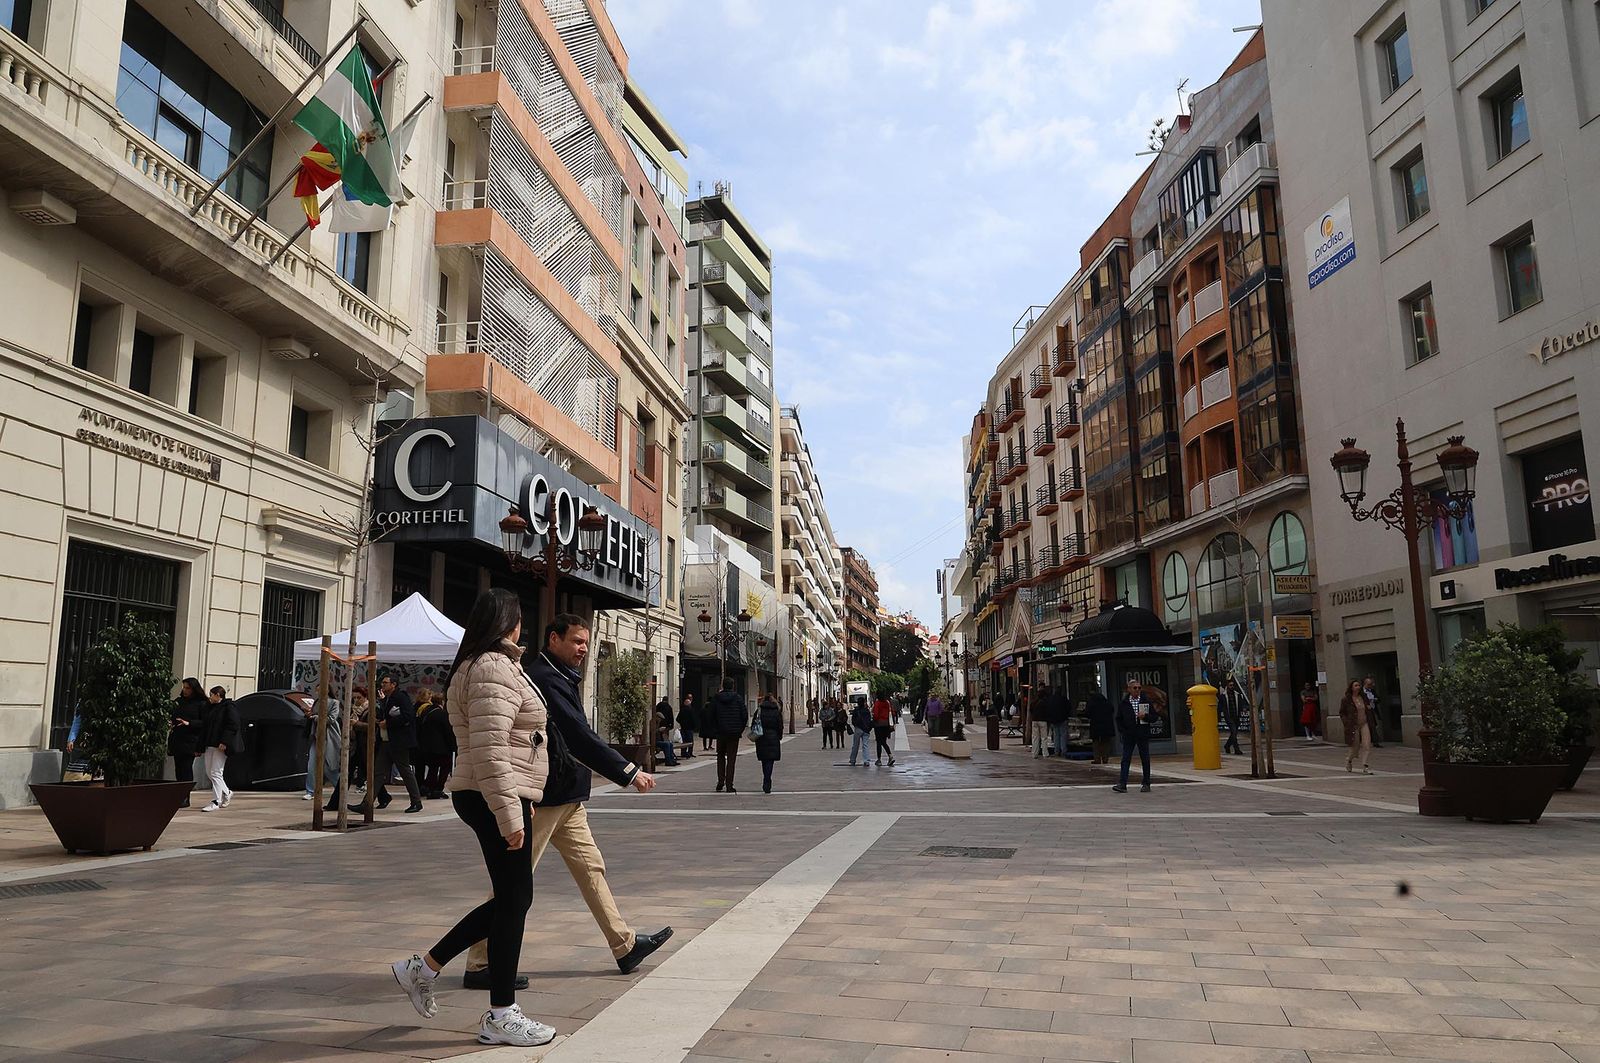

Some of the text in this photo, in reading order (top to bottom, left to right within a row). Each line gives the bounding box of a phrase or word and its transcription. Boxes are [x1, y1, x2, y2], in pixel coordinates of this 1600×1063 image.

[78, 407, 212, 464] AYUNTAMIENTO DE HUELVA
[393, 428, 456, 502] C
[1542, 478, 1590, 512] PRO
[375, 508, 469, 526] CORTEFIEL
[1328, 577, 1404, 607] TORRECOLON
[1126, 670, 1161, 686] GOIKO
